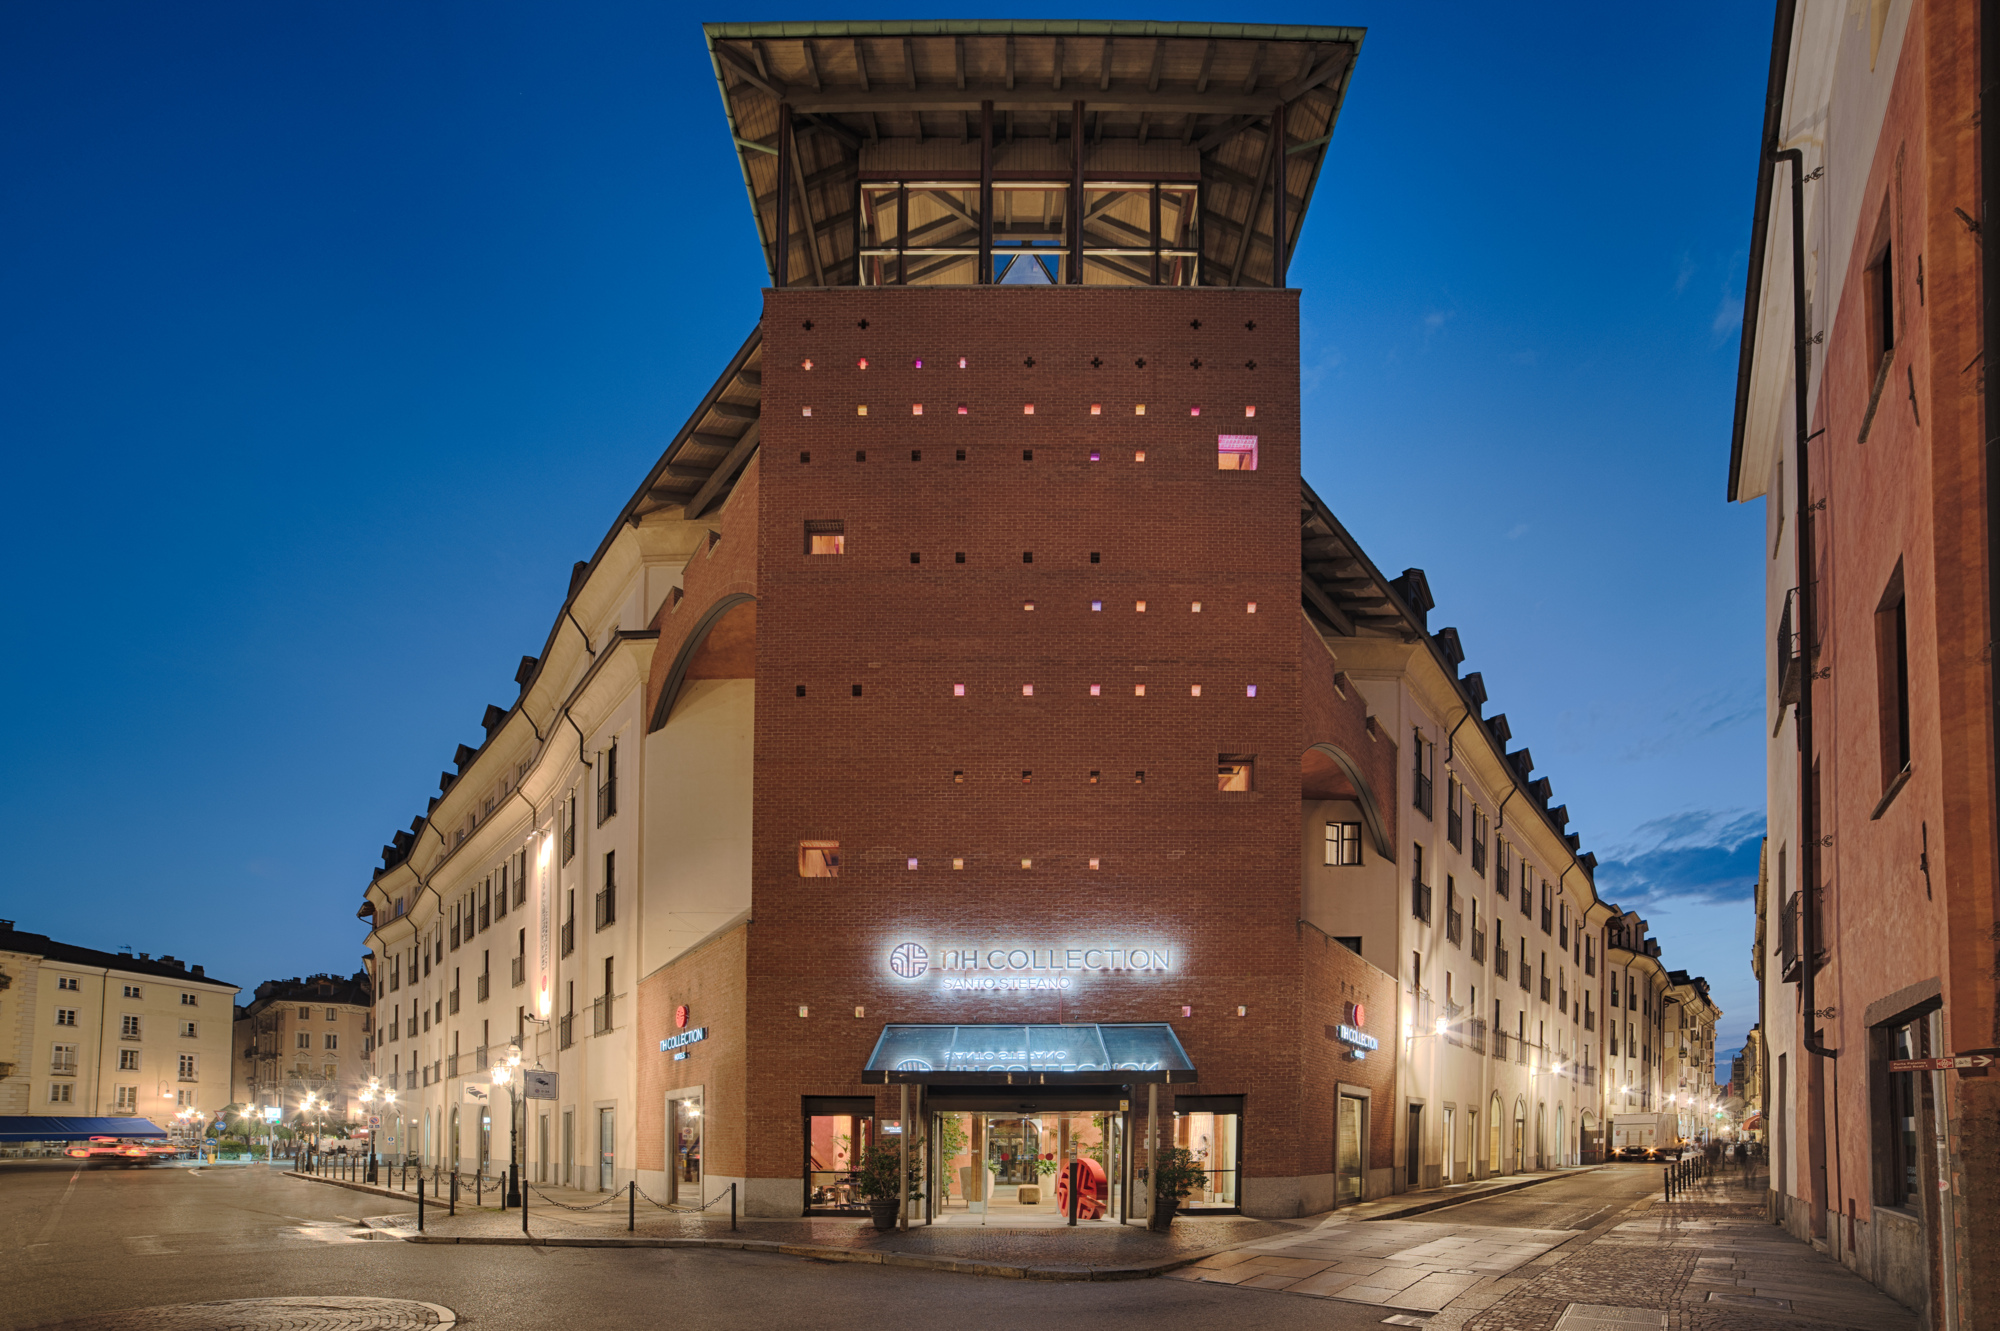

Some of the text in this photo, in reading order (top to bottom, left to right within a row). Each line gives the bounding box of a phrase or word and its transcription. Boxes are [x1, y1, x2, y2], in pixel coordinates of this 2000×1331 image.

[986, 949, 1170, 970] COLLECTION
[942, 977, 1071, 989] SANTO STEFANO
[667, 1028, 703, 1050] COLLECTION
[1349, 1028, 1378, 1050] COLLECTION
